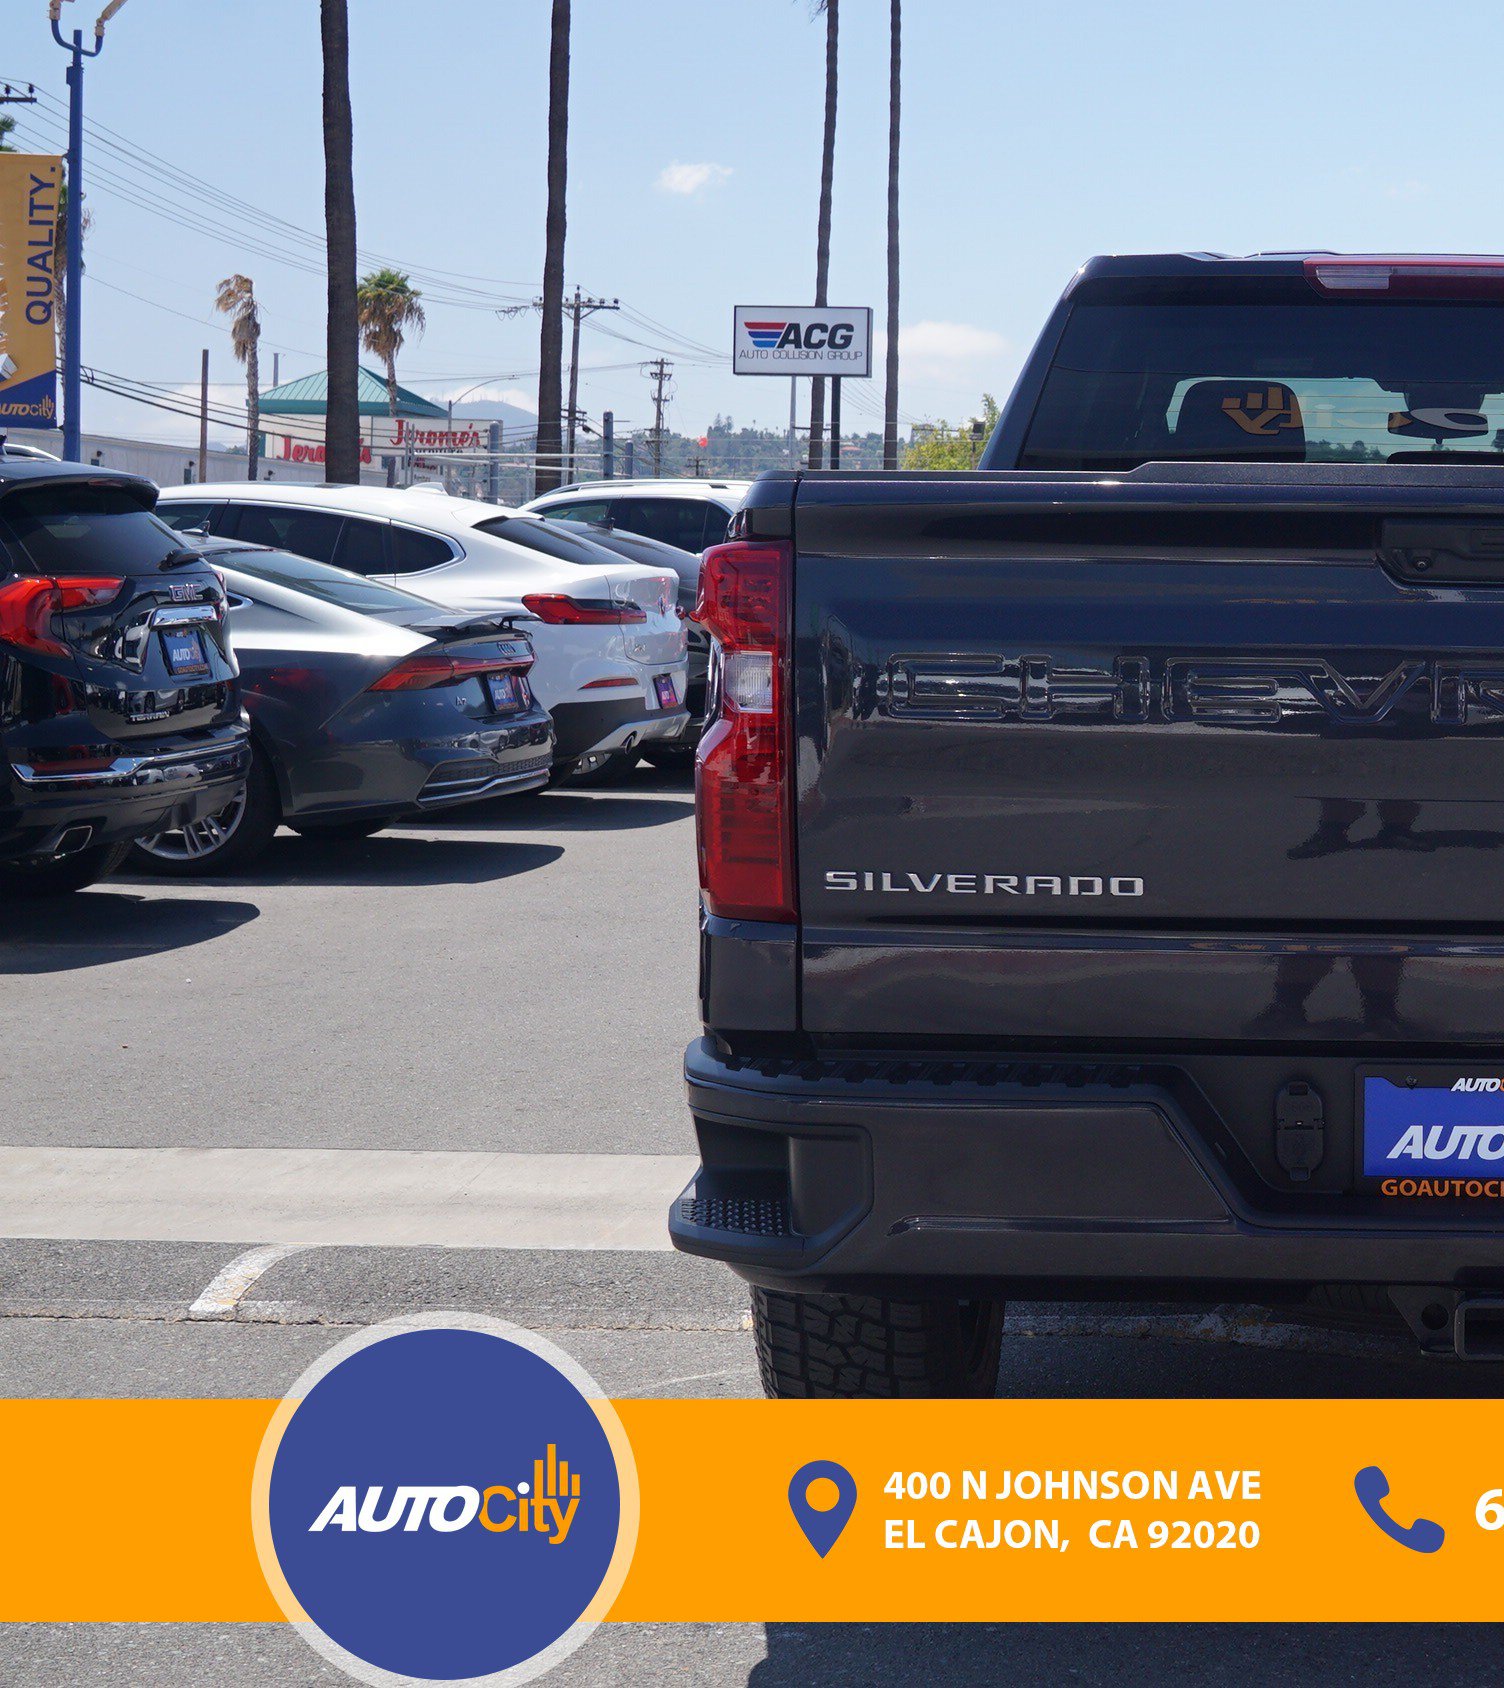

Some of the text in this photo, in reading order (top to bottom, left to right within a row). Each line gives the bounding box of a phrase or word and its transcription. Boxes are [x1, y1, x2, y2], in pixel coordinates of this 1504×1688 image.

[26, 167, 56, 325] QUALITY.
[777, 322, 855, 350] ACG
[739, 349, 863, 361] AUTO COLLISION GROUP
[0, 398, 55, 419] UTOCity
[168, 584, 204, 602] GMC
[825, 871, 1145, 897] SILVERADO
